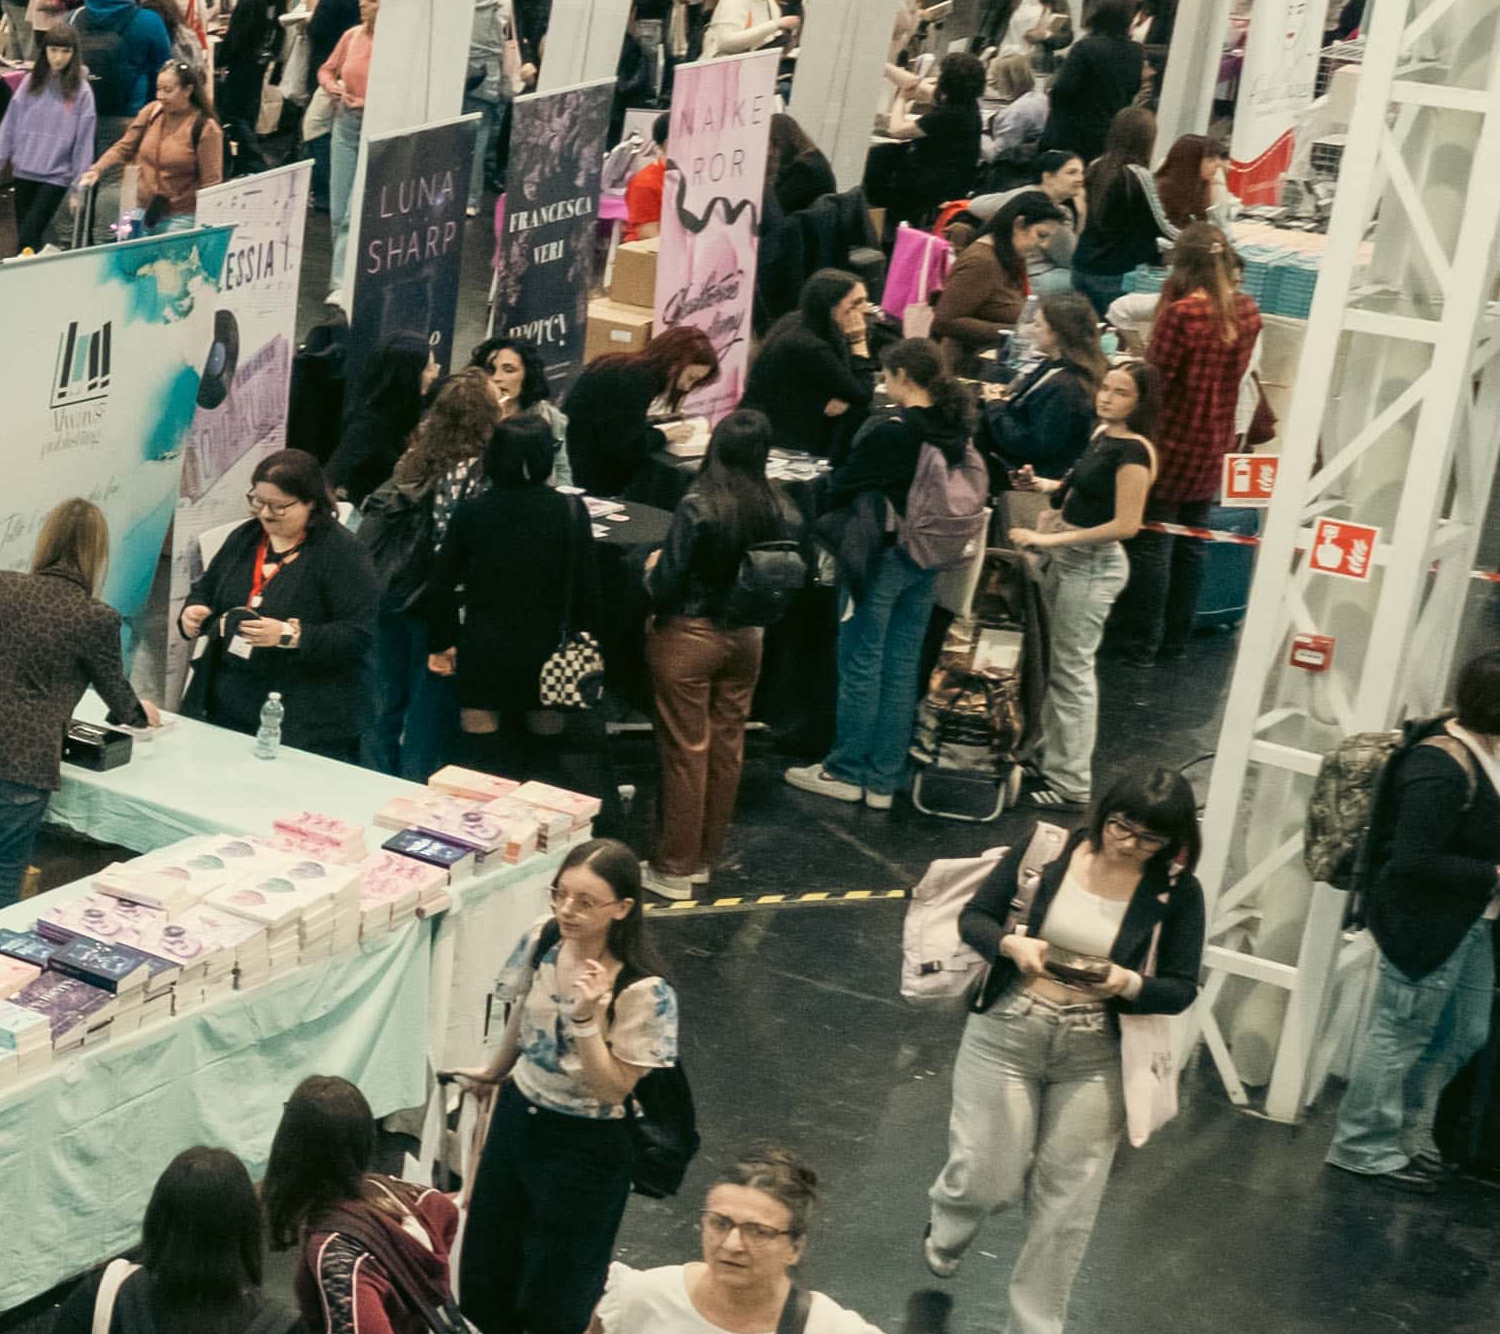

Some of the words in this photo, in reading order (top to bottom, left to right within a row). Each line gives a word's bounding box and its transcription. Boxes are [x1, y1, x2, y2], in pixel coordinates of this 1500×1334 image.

[678, 95, 764, 137] NAIKE
[692, 148, 745, 187] ROR
[380, 170, 455, 218] LUNA
[509, 195, 593, 234] FRANCESCA
[365, 221, 457, 275] SHARP
[533, 238, 565, 265] VERI
